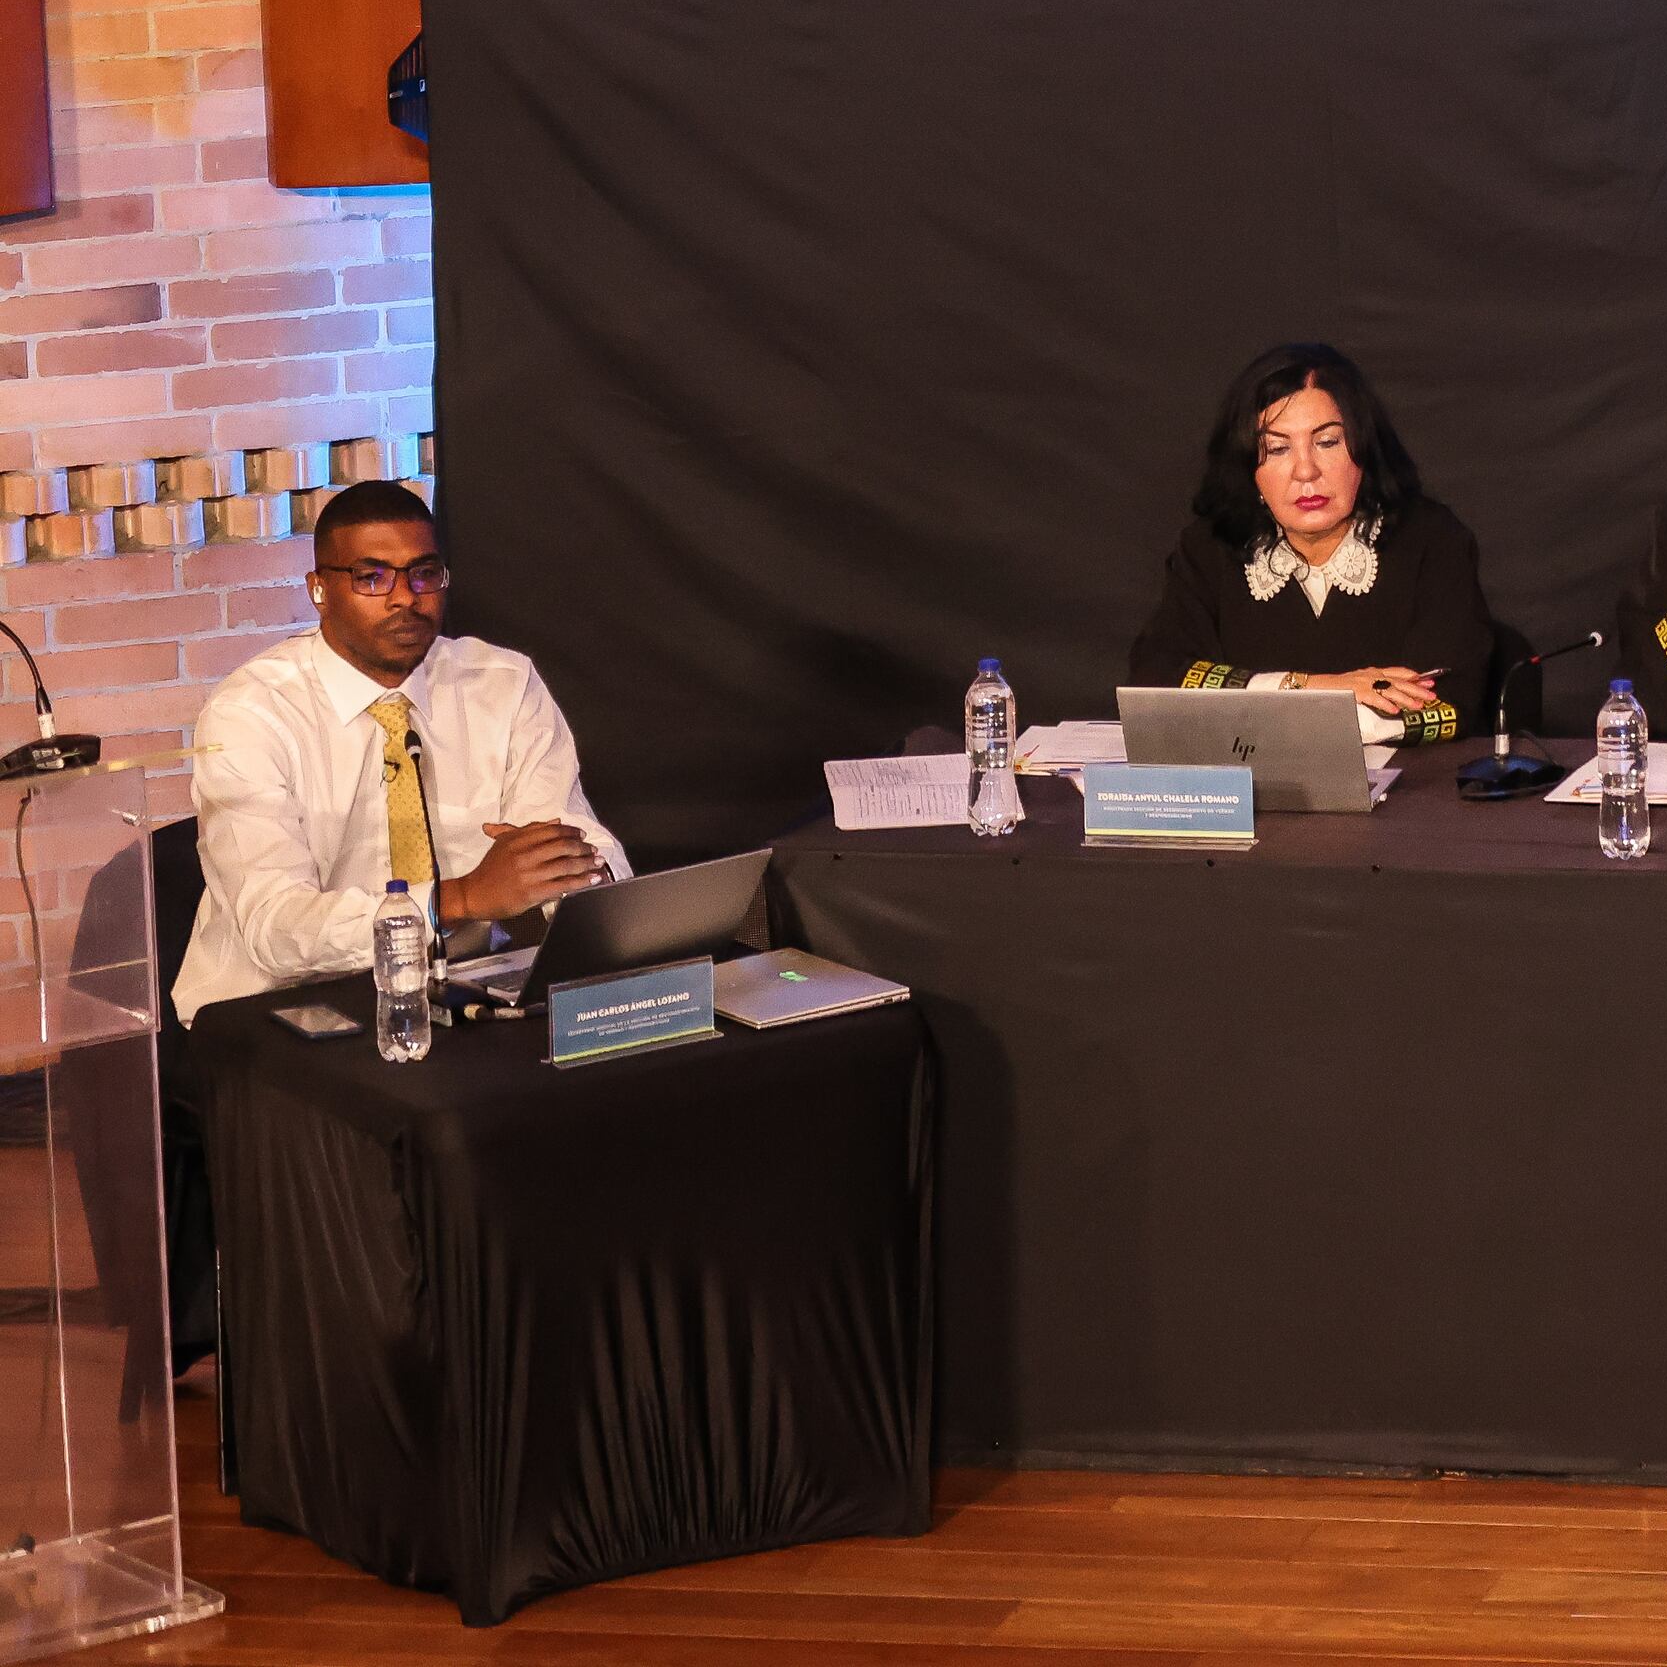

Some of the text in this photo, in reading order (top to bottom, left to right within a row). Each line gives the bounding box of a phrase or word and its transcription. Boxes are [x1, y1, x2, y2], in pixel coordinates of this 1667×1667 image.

[1232, 736, 1256, 762] hp
[1097, 792, 1134, 803] ZORAIDA
[1163, 793, 1200, 804] CHALELA
[1201, 795, 1240, 805] ROMANO
[576, 992, 690, 1023] JUAN CARLOS ÁNGEL LOZANO
